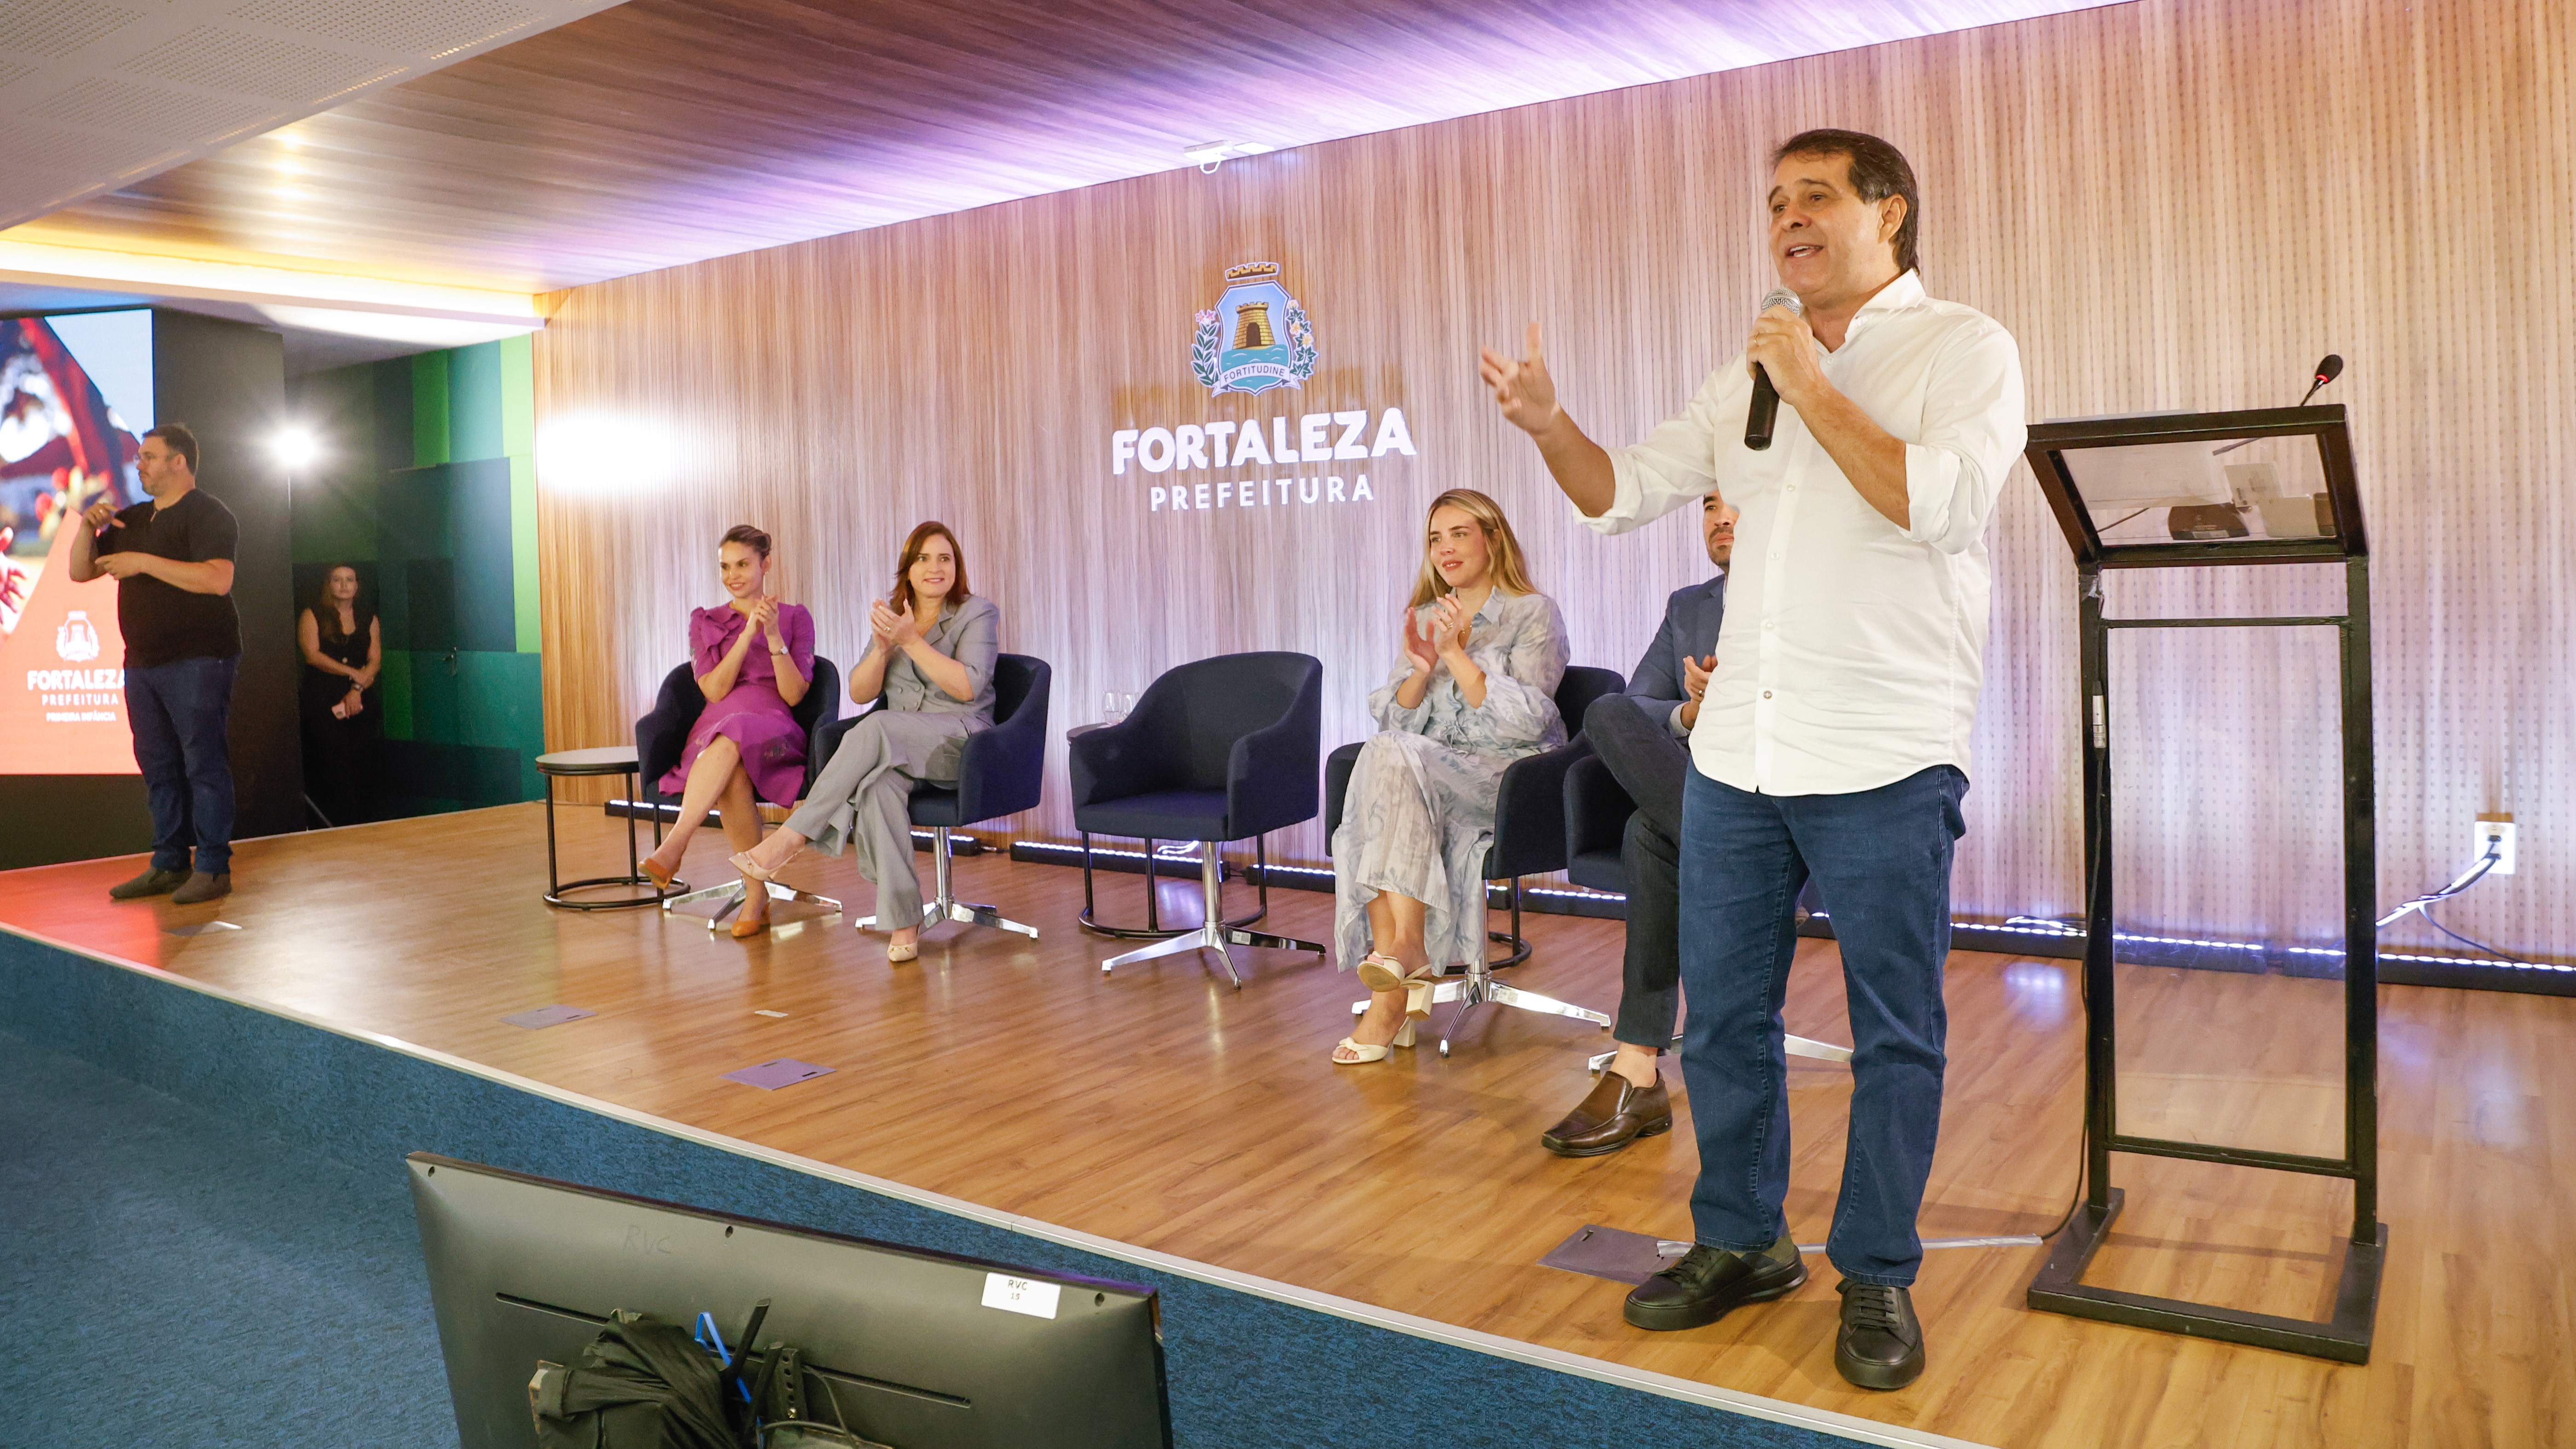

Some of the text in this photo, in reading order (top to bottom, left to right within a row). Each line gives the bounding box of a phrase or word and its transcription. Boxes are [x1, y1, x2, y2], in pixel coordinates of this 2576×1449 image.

[1224, 366, 1285, 382] FORTITUDINE
[1112, 407, 1417, 475] FORTALEZA
[1151, 474, 1374, 512] PREFEITURA
[41, 693, 119, 706] PREFEITURA
[1008, 1280, 1028, 1290] RVC
